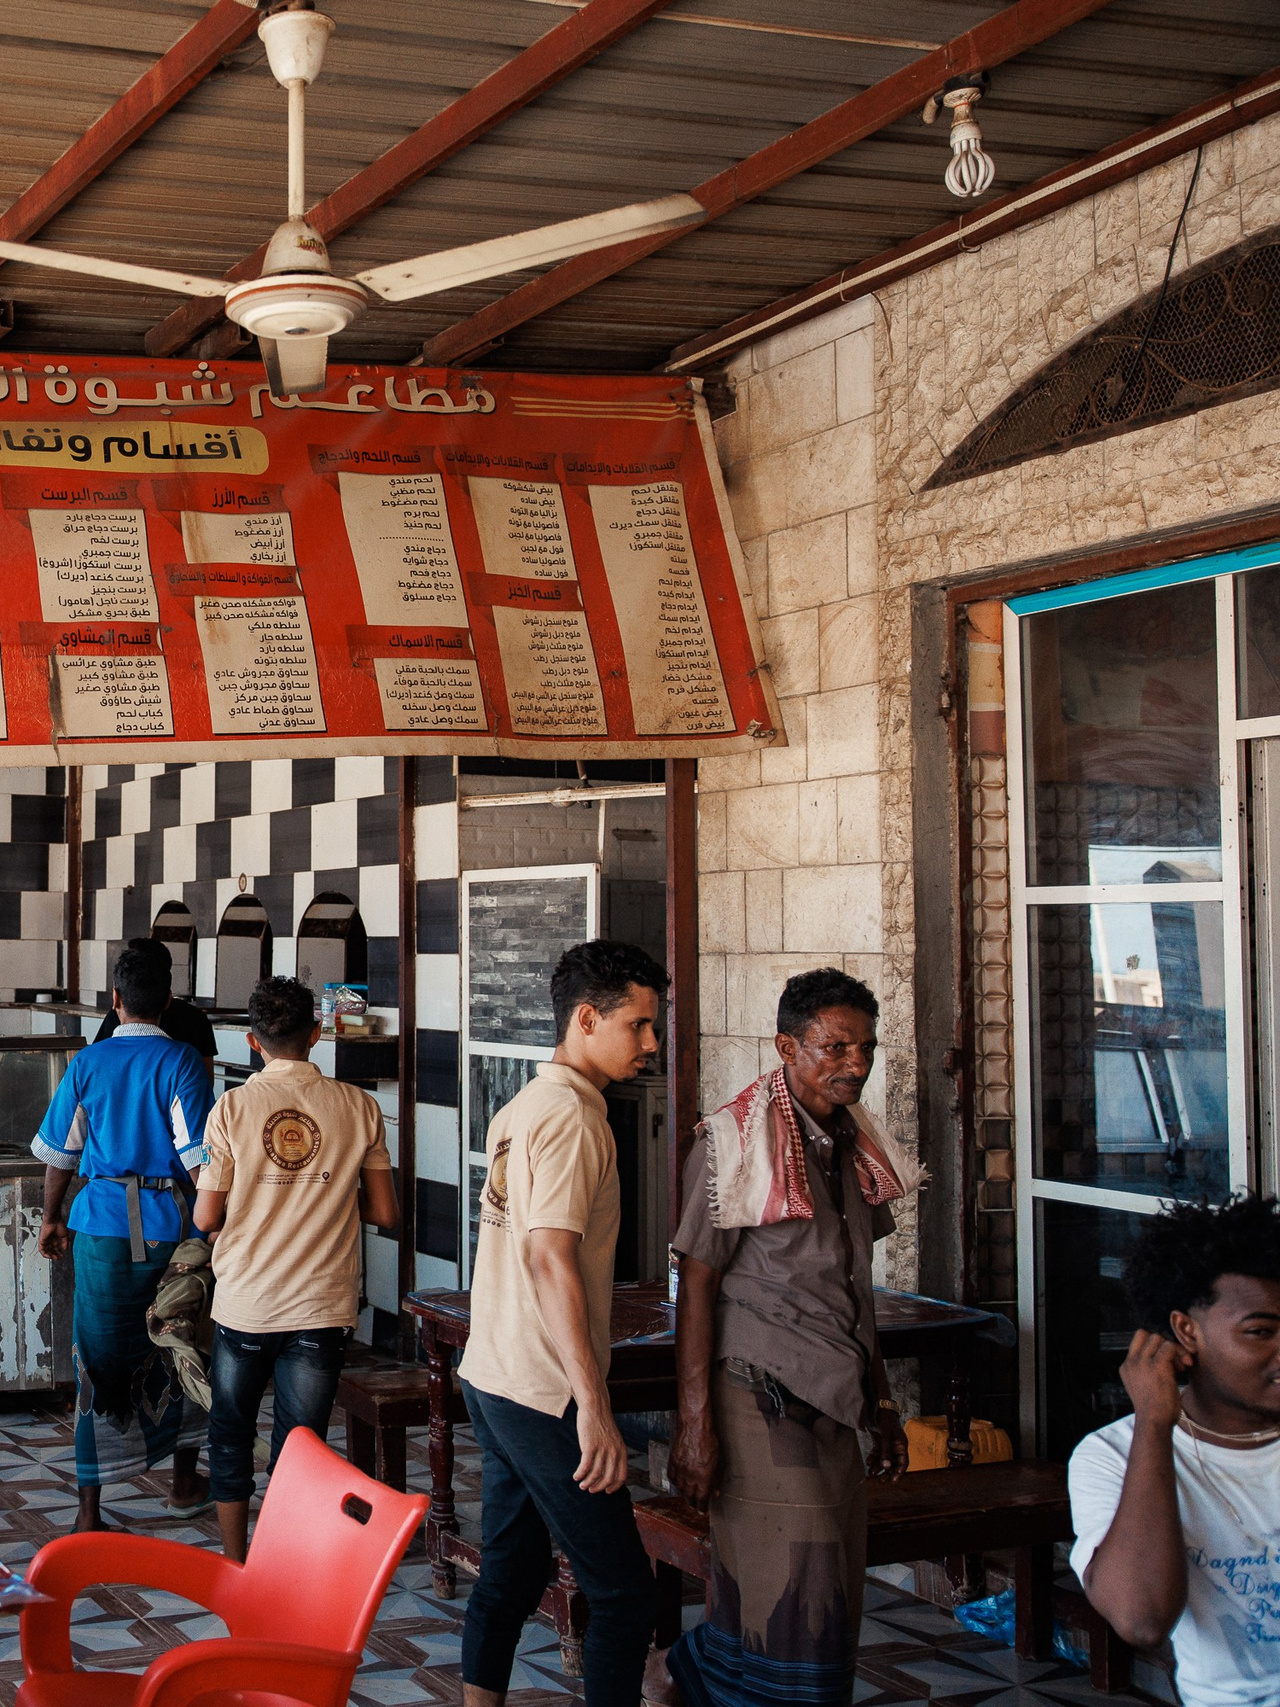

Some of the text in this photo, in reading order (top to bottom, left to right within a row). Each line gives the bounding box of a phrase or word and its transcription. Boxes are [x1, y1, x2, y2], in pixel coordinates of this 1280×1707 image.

[44, 361, 235, 414] شبوة
[103, 430, 243, 463] أقسام
[362, 451, 390, 463] اللحم
[392, 454, 420, 465] قسم
[389, 479, 412, 487] مندي
[42, 488, 127, 504] قسم البرست
[213, 491, 270, 508] قسم الأرز
[67, 514, 83, 522] بارد
[271, 516, 281, 525] أرز
[63, 525, 137, 535] برست دجاج حراق
[404, 546, 425, 555] مندي
[250, 552, 286, 562] أرز بخاري
[116, 575, 143, 583] برست
[554, 570, 568, 578] فول
[508, 585, 561, 601] قسم الخبز
[60, 629, 151, 652] قسم المشاوي
[436, 638, 463, 650] قسم
[659, 639, 682, 648] جمبري
[214, 668, 308, 681] سحاوق مجروش عادي
[396, 665, 416, 674] مقلي
[542, 668, 588, 676] ملوح دبل رطب
[79, 670, 158, 683] طبق مشاوي كبير
[687, 686, 716, 694] مشكل
[117, 709, 163, 719] كباب لحم
[259, 718, 315, 730] سحاوق عدني
[705, 721, 724, 729] بيض
[288, 1141, 319, 1169] Restaurants
